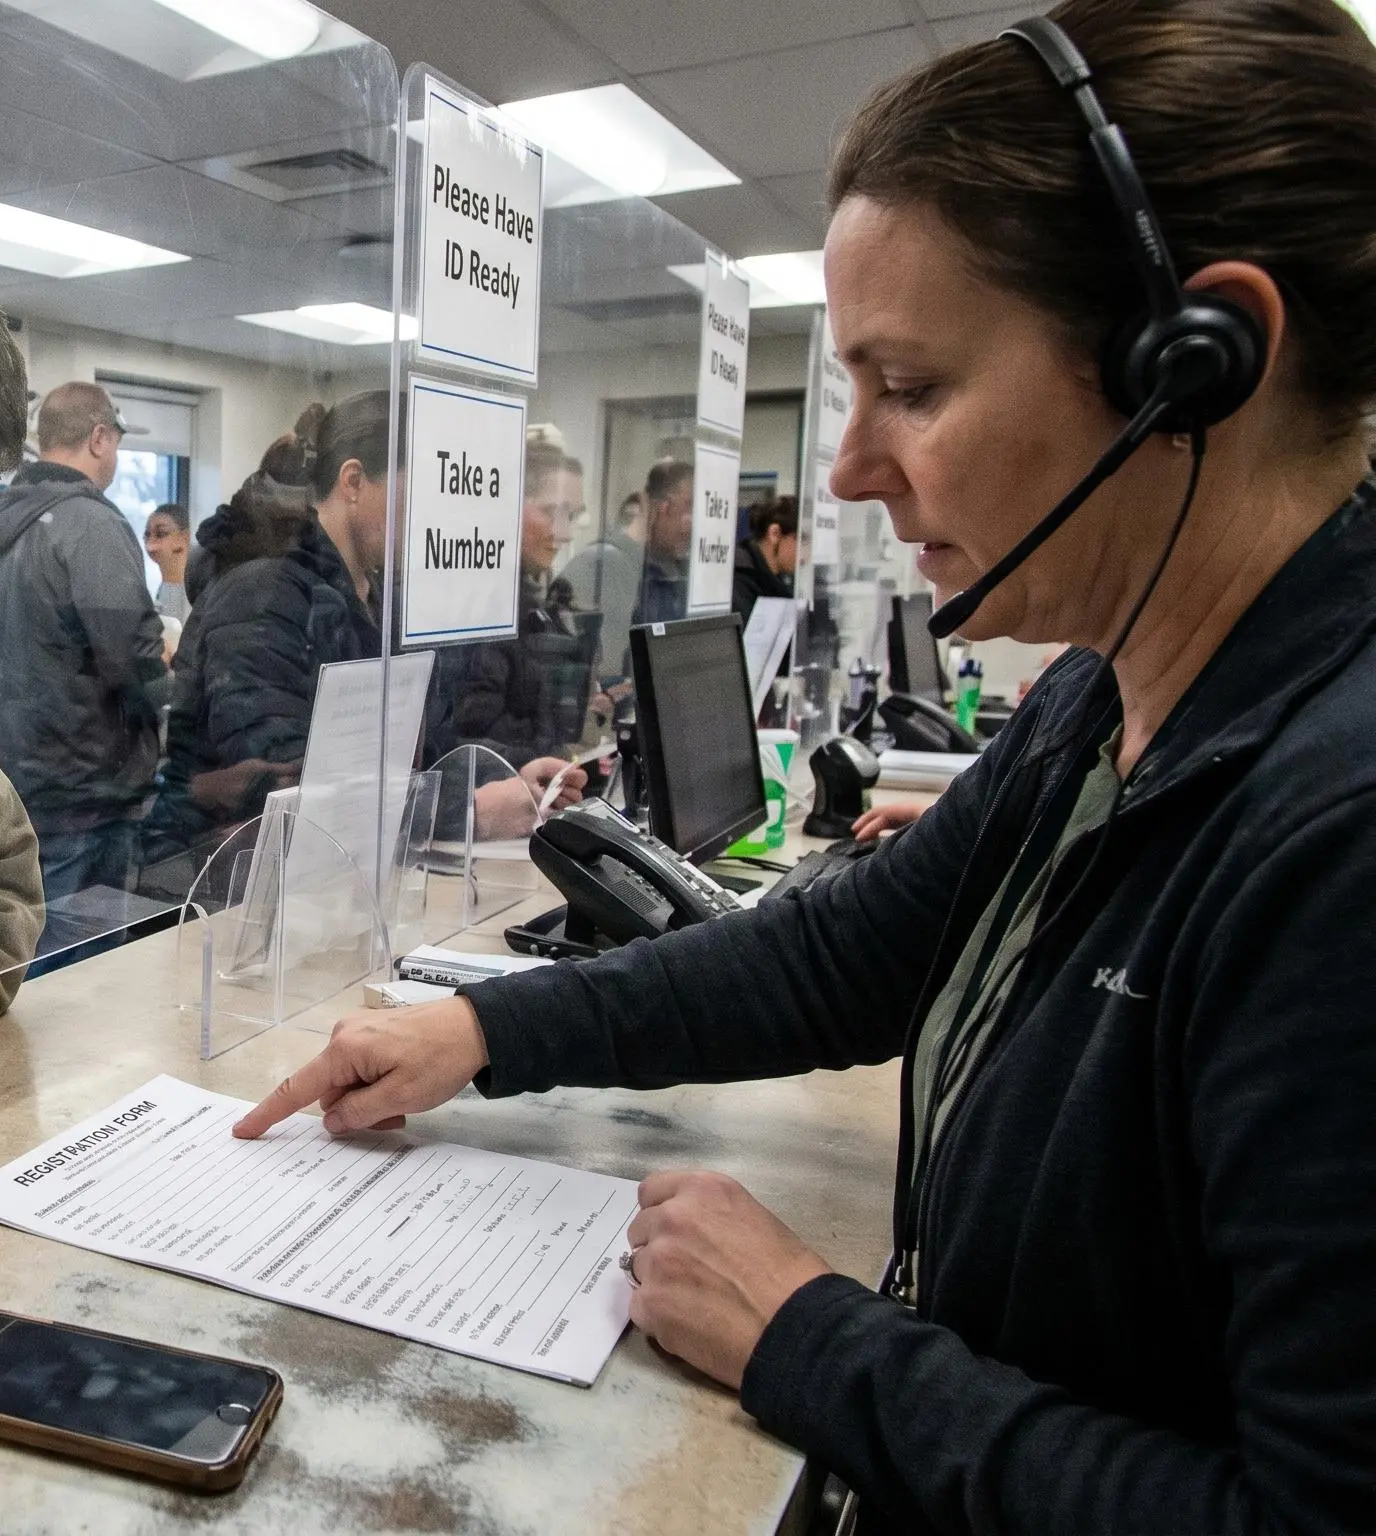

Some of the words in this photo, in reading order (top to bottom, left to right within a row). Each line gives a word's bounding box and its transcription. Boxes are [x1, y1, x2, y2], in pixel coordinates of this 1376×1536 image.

[433, 164, 490, 225] Please
[495, 193, 533, 244] Have
[445, 239, 464, 281] ID
[469, 249, 520, 310] Ready
[437, 450, 483, 497] Take
[489, 467, 500, 498] a
[425, 526, 504, 570] Number
[113, 1100, 157, 1127] FORM
